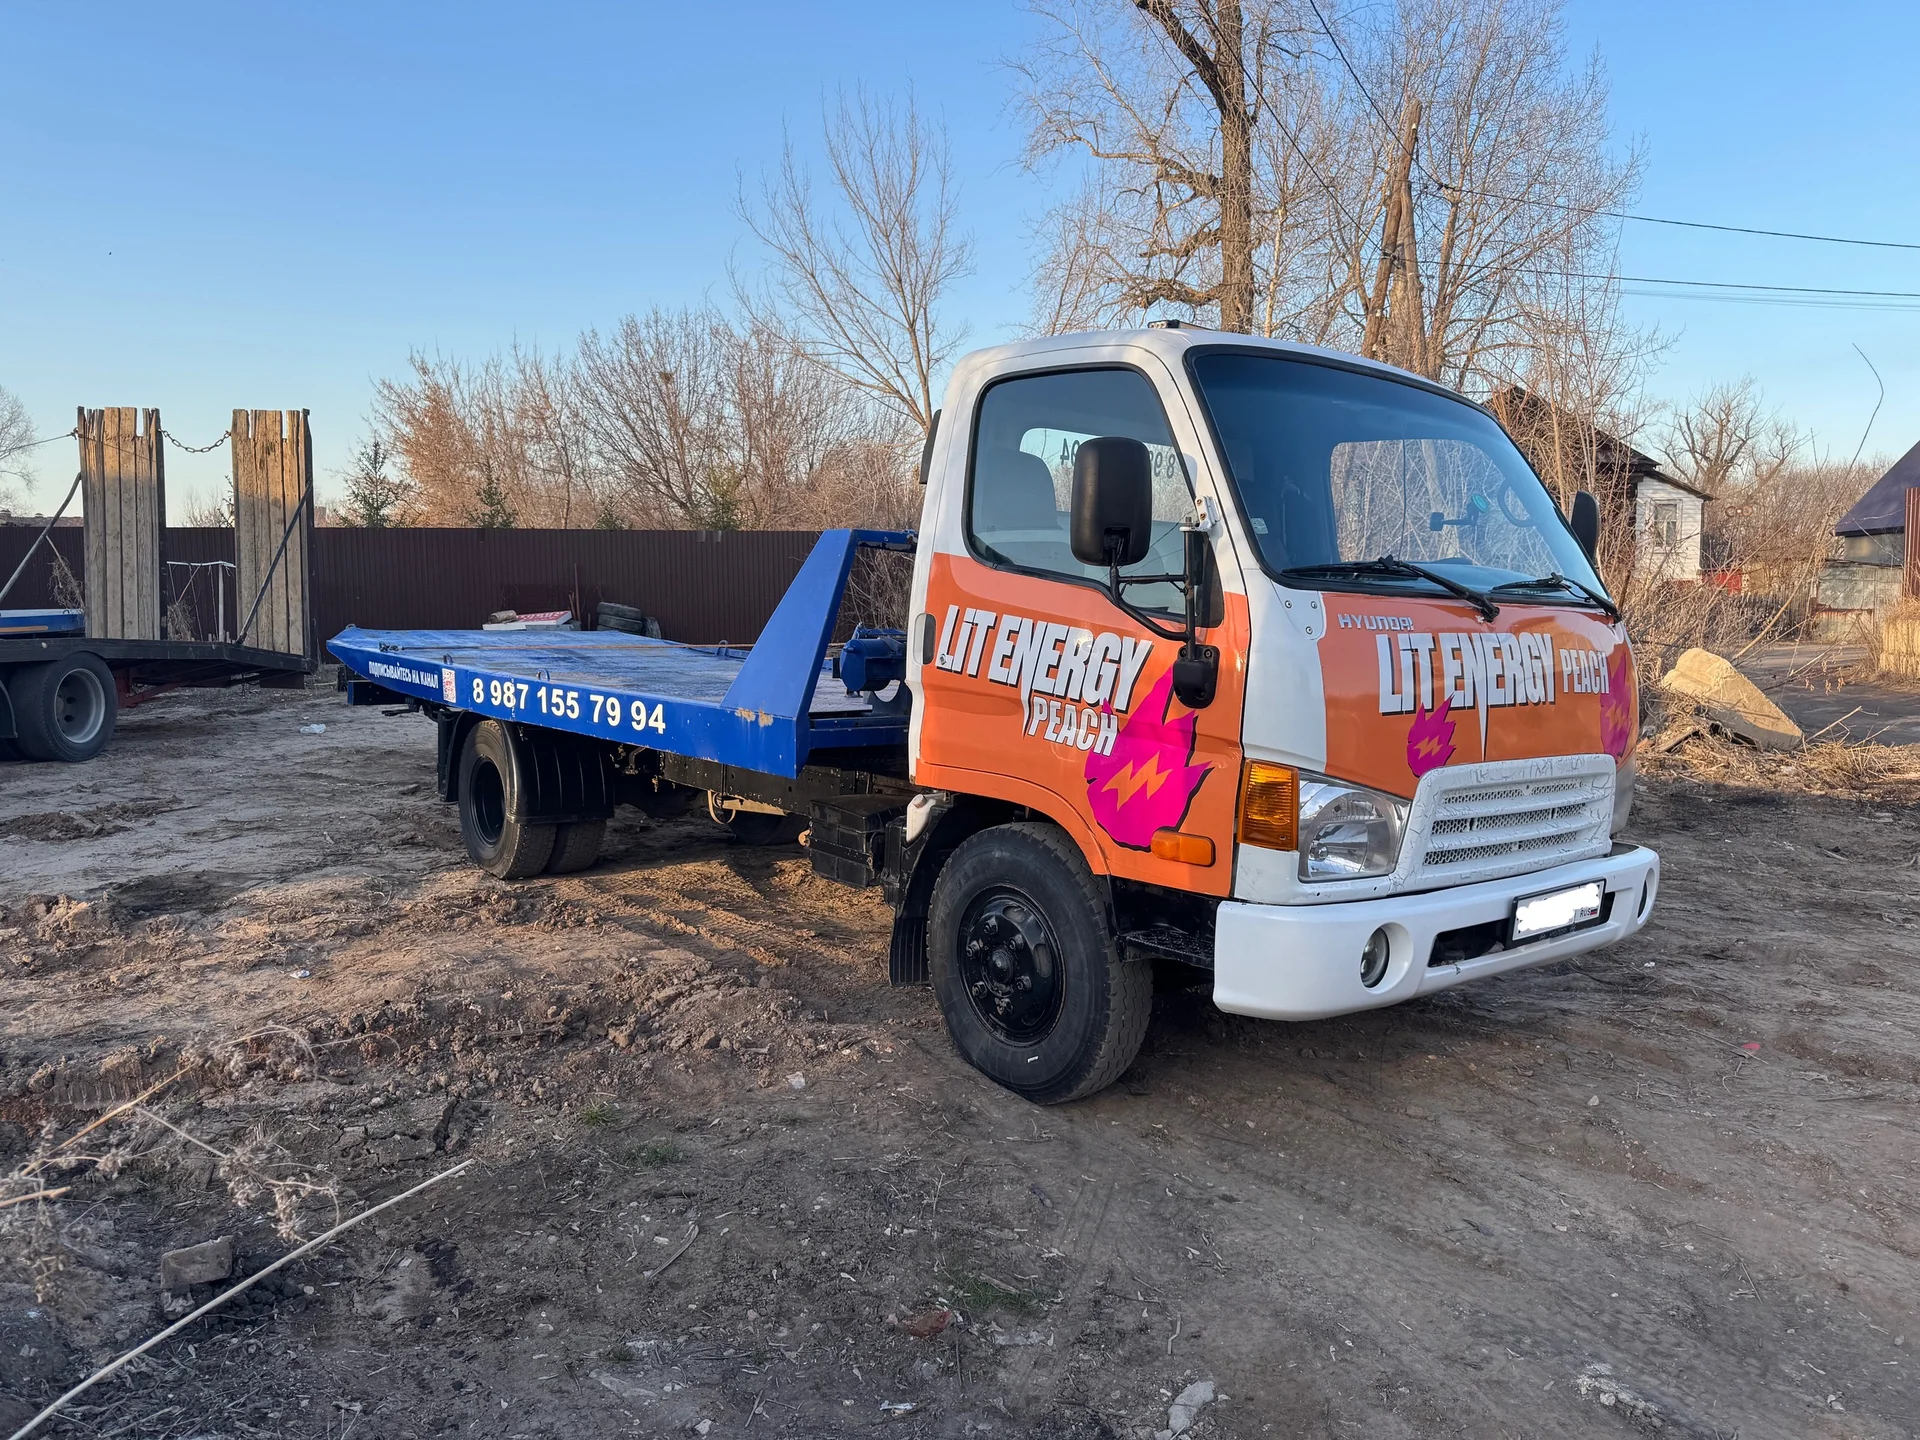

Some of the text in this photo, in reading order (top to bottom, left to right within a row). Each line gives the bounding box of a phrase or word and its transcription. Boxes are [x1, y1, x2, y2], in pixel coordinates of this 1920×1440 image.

[1337, 613, 1414, 631] HYUNDAI
[411, 669, 420, 685] НА
[420, 671, 439, 689] КАНАЛ
[987, 613, 1153, 738] ENERGY
[1439, 632, 1556, 762] ENERGY
[1559, 648, 1610, 694] PEACH
[472, 678, 667, 735] 8 987 155 79 94
[1027, 696, 1119, 757] PEACH
[1580, 907, 1591, 918] RUS
